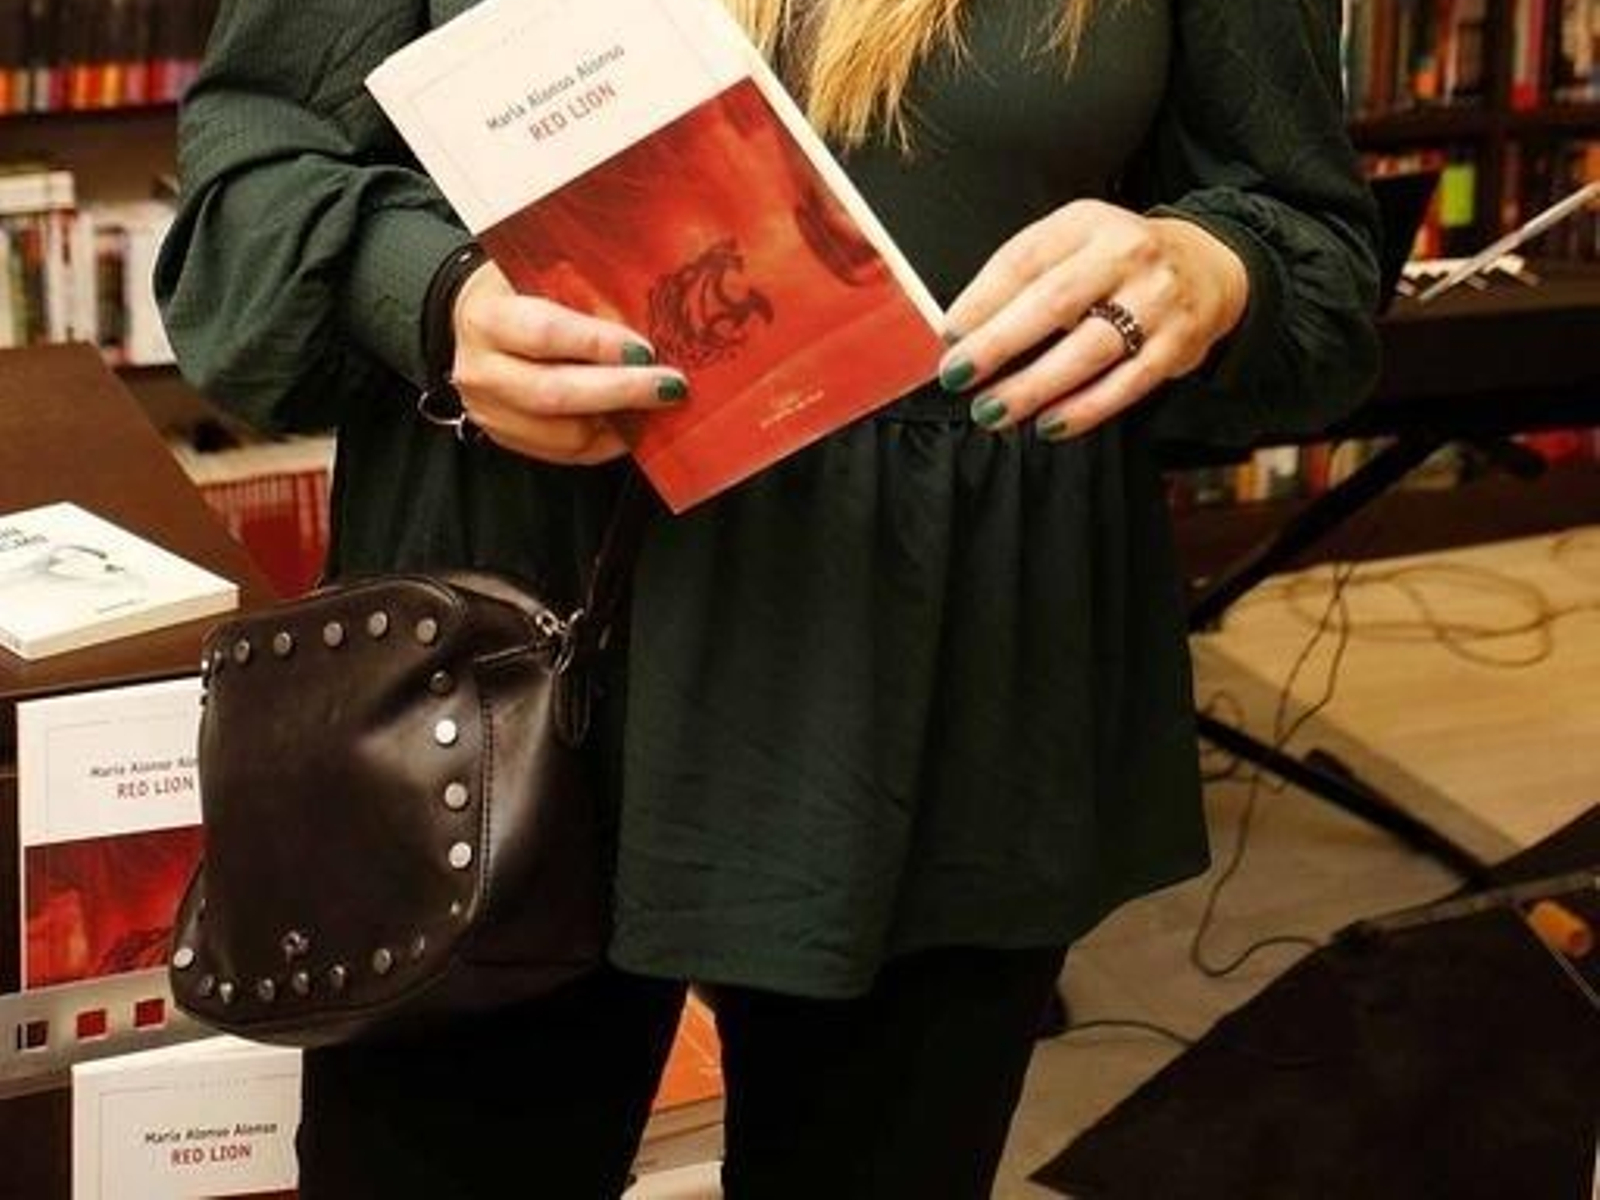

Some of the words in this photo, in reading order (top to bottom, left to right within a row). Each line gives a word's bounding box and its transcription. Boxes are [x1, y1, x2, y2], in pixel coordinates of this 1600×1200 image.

[527, 76, 575, 109] Alonso
[528, 112, 569, 142] RED
[567, 81, 617, 120] LION
[117, 781, 149, 799] RED
[154, 775, 194, 795] LION
[171, 1147, 205, 1165] RED
[210, 1144, 251, 1162] LION
